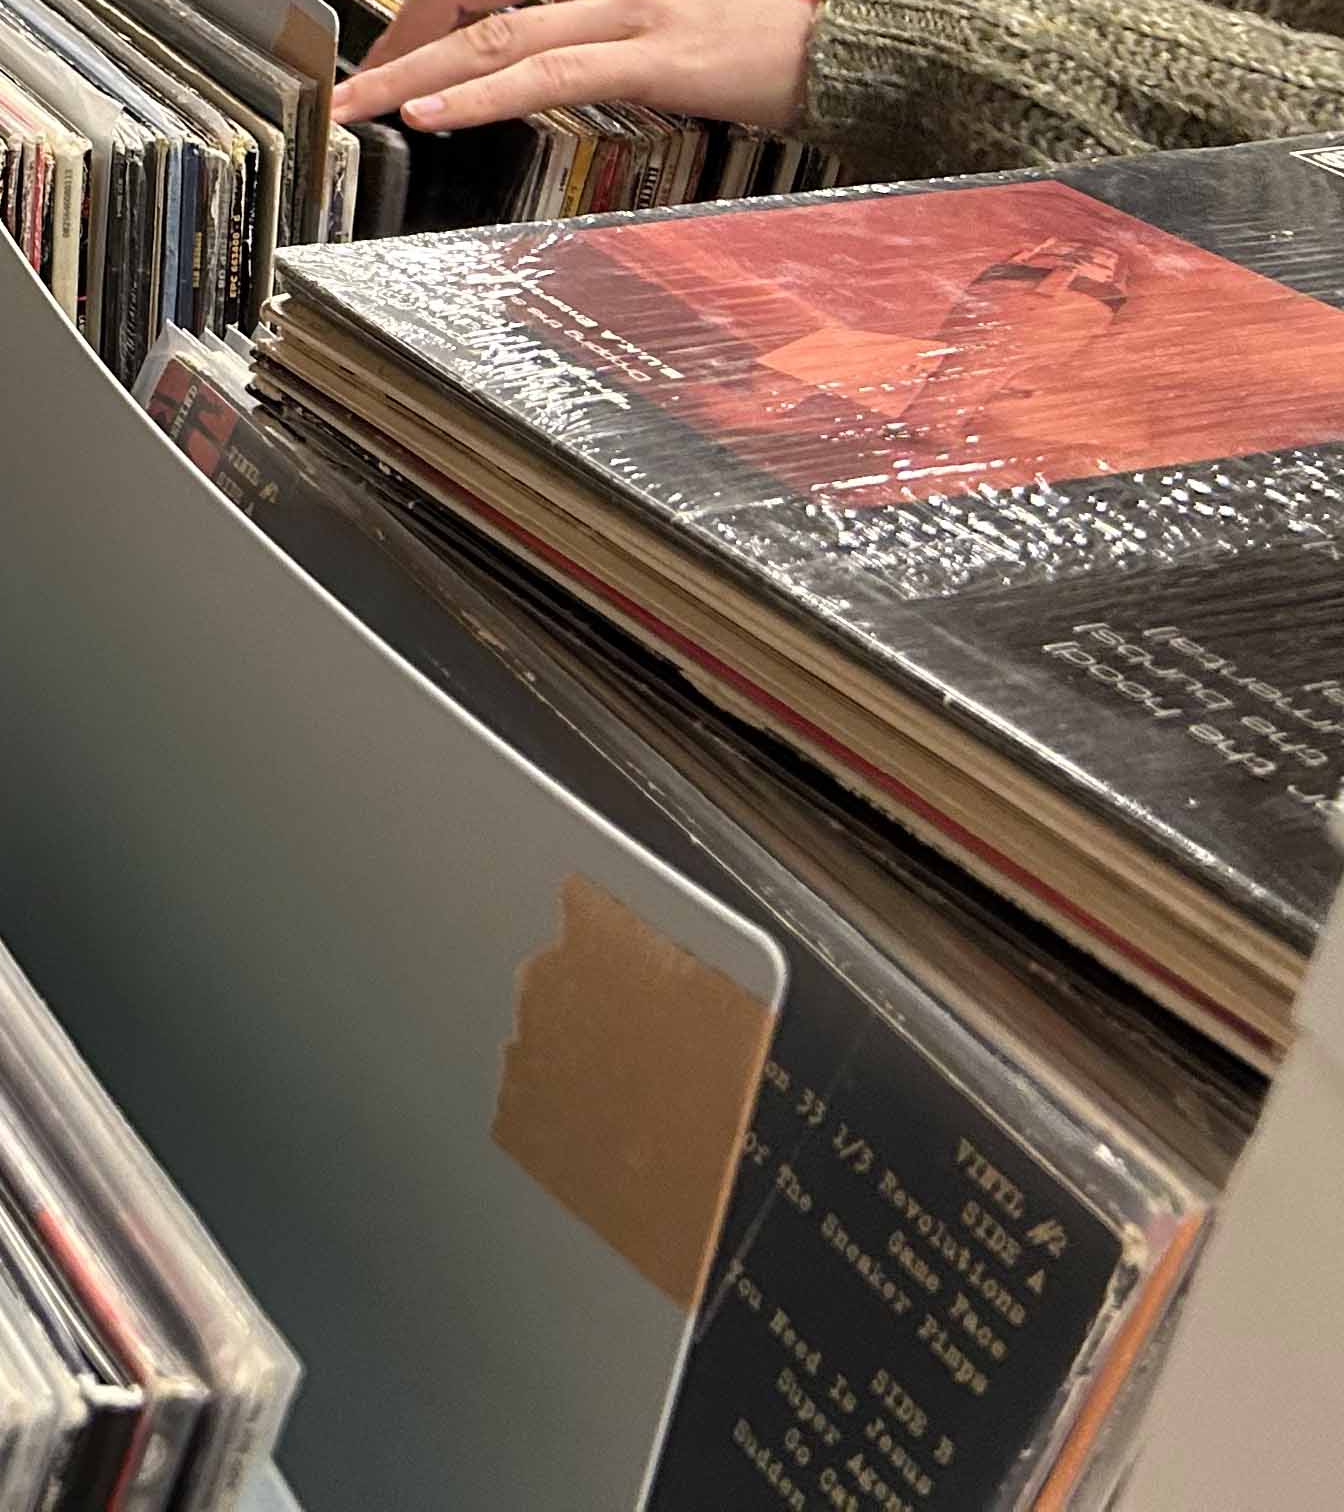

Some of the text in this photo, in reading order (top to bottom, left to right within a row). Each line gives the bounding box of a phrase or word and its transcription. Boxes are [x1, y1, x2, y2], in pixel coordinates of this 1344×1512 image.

[957, 1135, 1025, 1220] VINYL
[960, 1198, 1048, 1296] SIDE A
